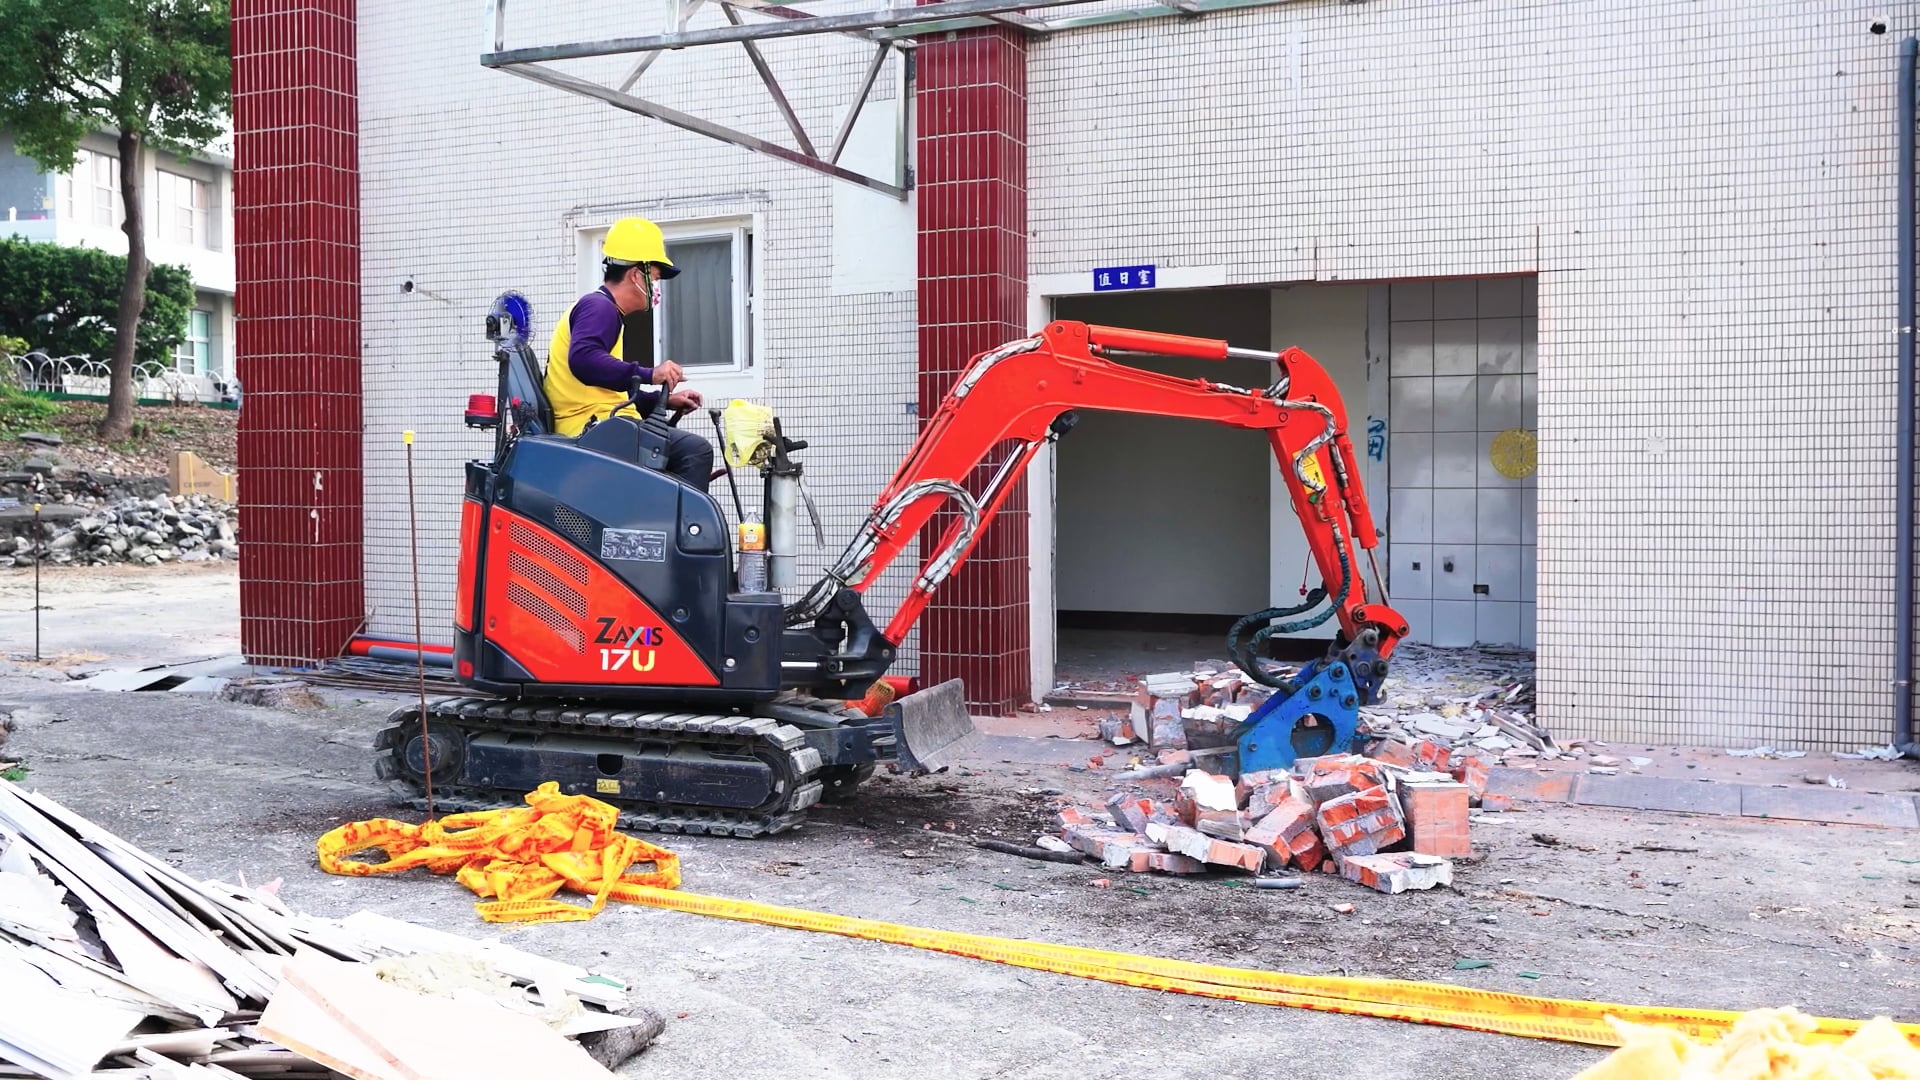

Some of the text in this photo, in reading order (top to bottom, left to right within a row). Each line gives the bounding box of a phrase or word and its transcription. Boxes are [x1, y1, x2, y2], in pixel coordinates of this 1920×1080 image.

[1098, 269, 1151, 286] 值日室
[593, 616, 664, 648] ZAXIS
[599, 648, 656, 672] 17U
